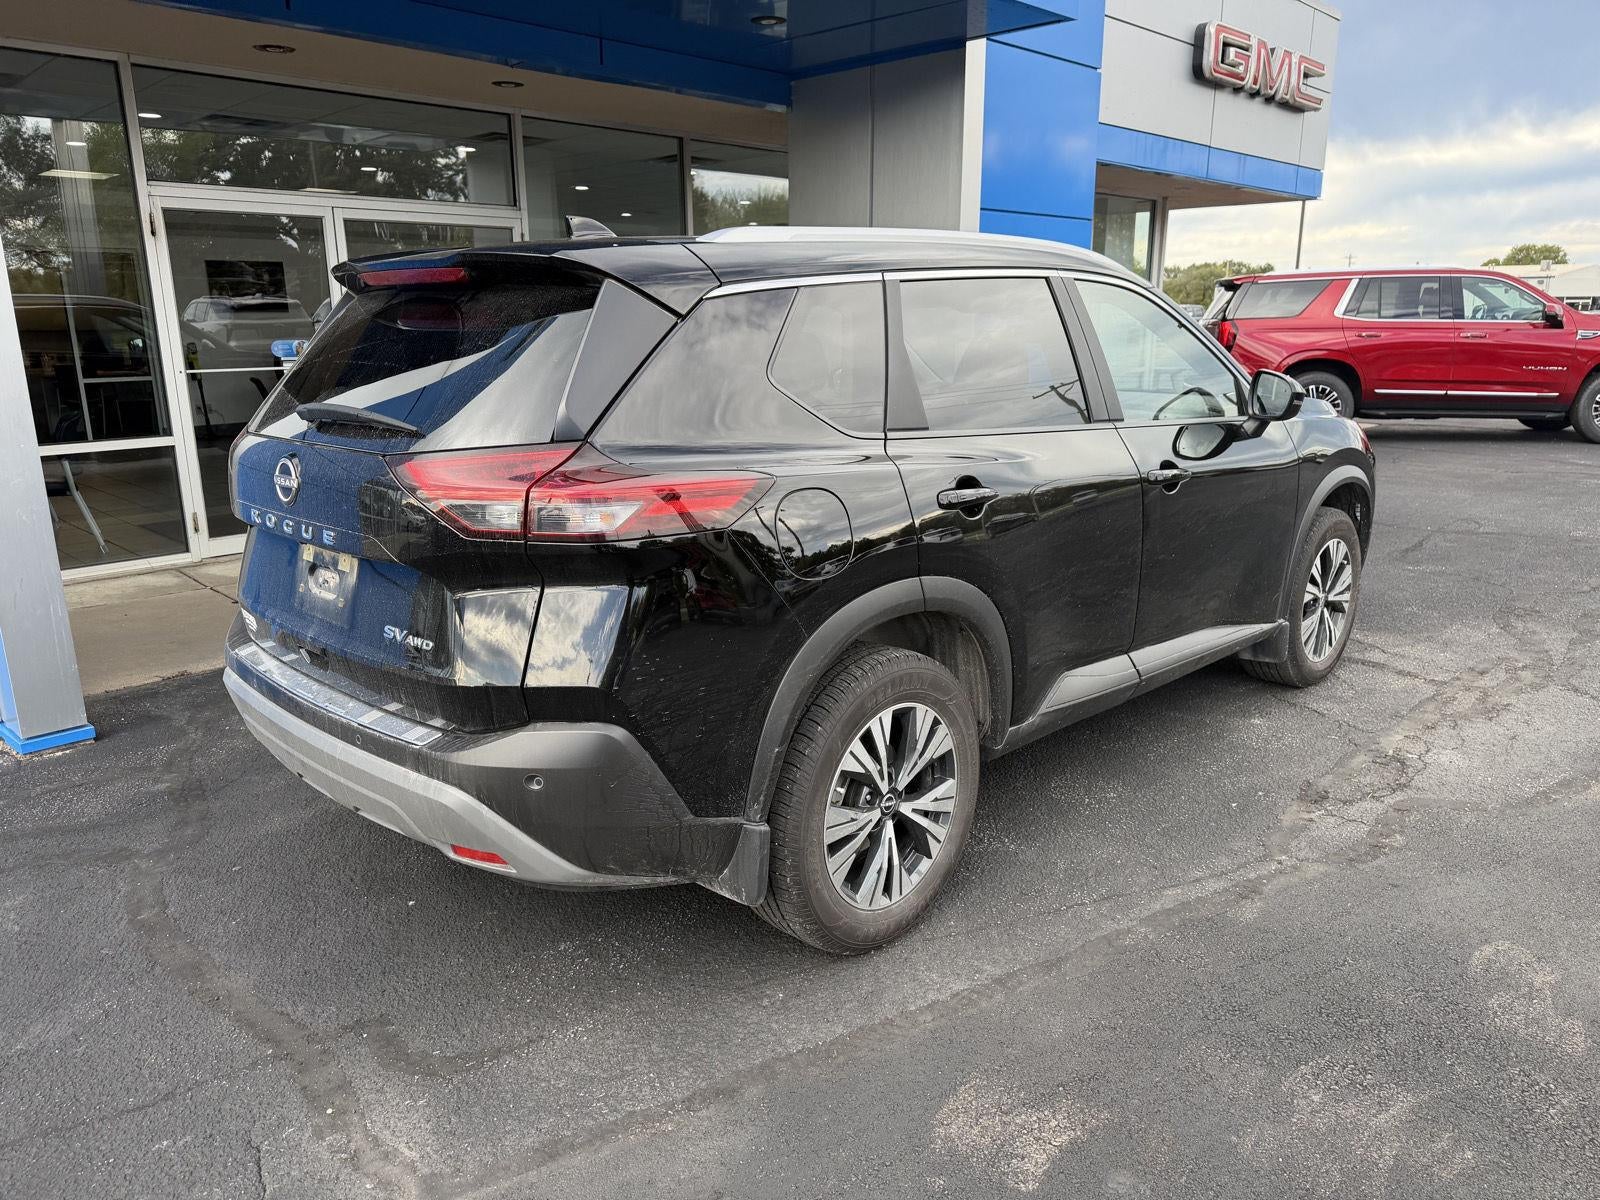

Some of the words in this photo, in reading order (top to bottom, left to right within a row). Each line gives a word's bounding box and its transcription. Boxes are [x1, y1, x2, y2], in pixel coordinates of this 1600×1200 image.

[1202, 21, 1327, 111] GMC
[274, 474, 298, 489] SSAN
[250, 508, 336, 546] ROGUE
[383, 624, 408, 643] SV
[404, 634, 434, 651] AWD
